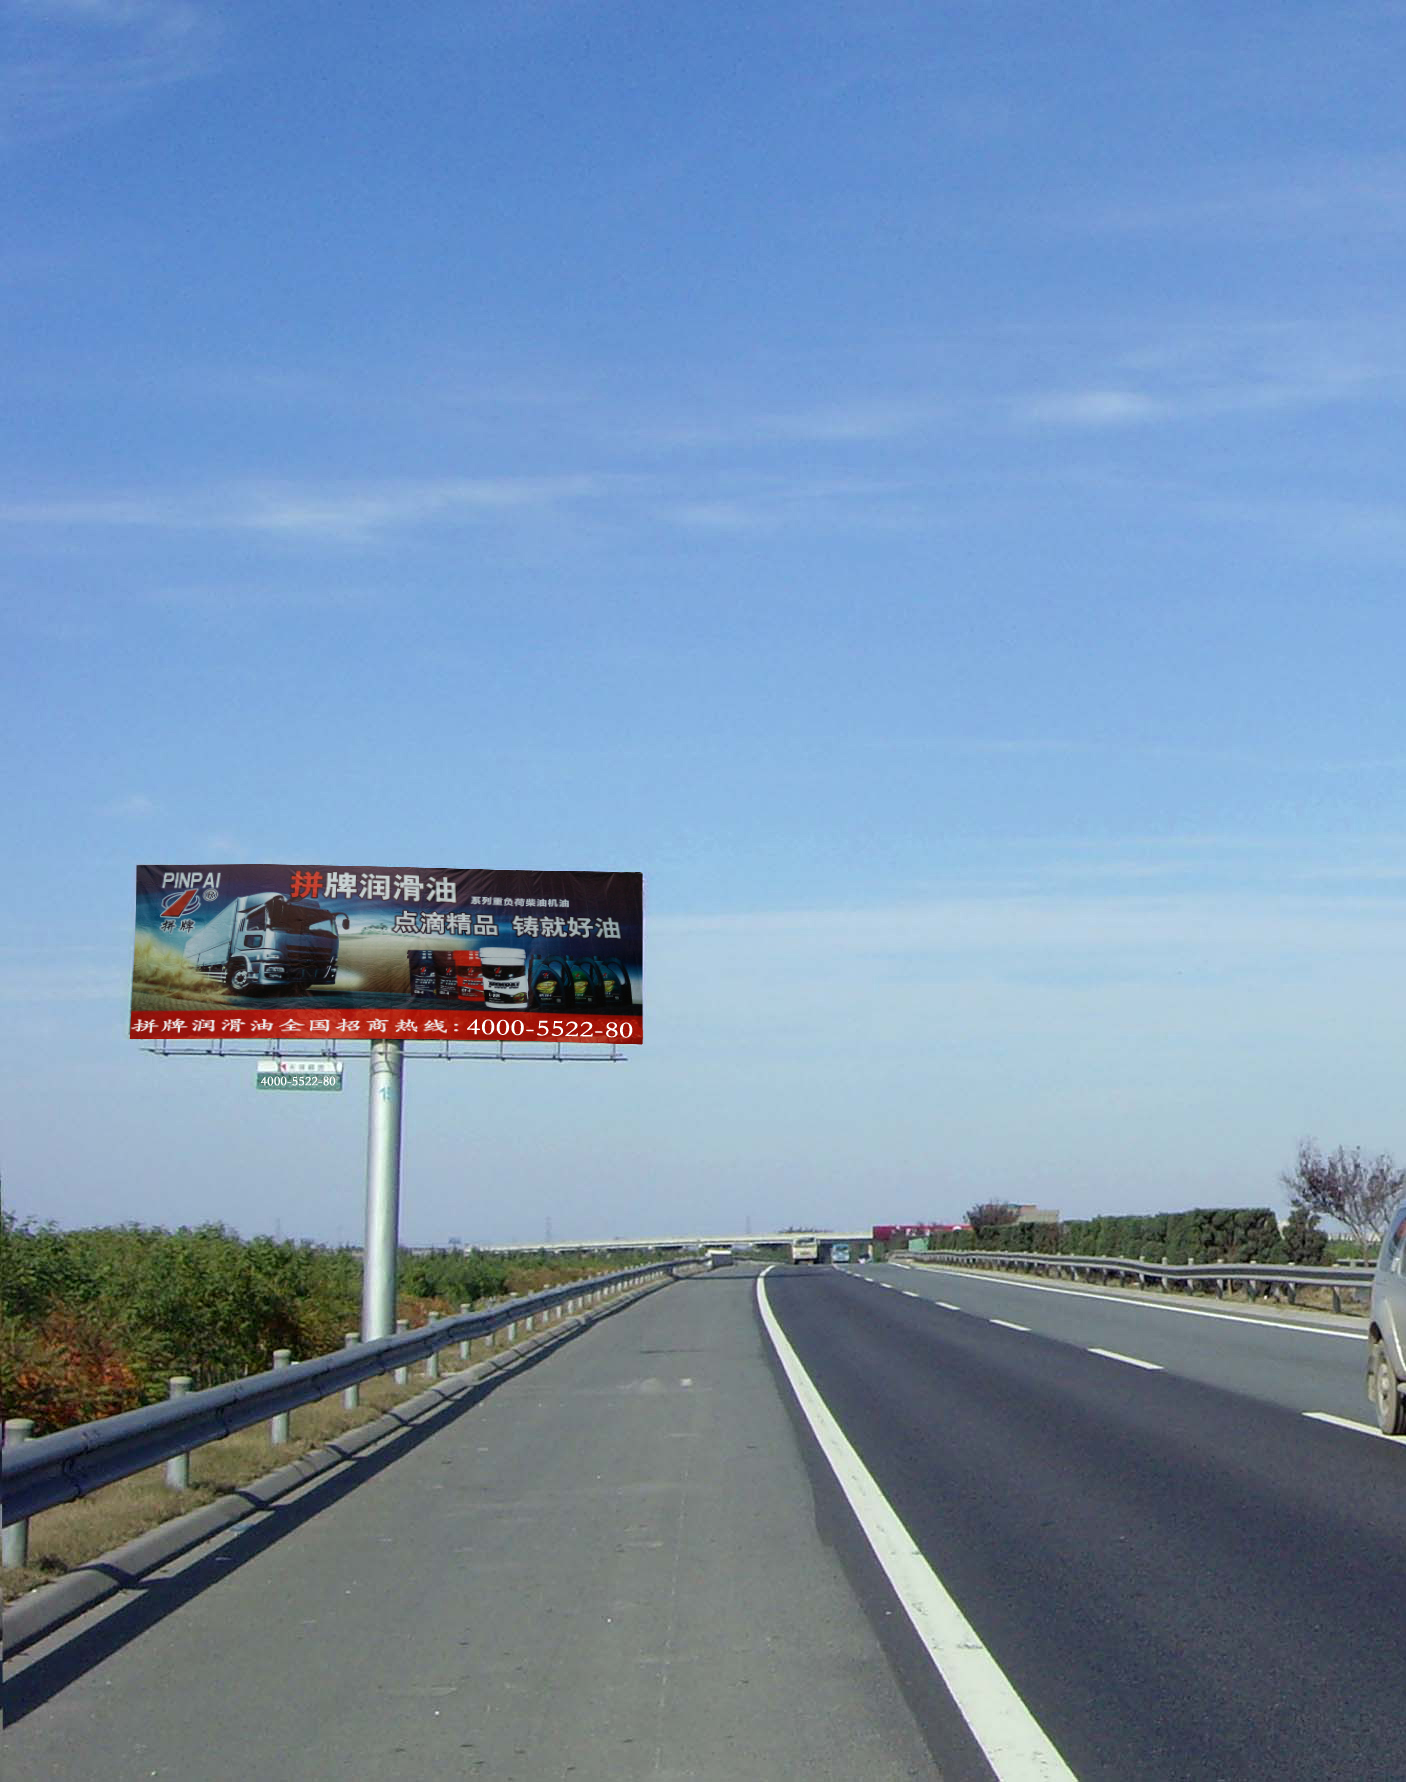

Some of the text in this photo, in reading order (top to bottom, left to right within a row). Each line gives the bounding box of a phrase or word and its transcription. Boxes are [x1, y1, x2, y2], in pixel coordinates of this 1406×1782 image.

[162, 872, 221, 889] PINPAI
[290, 871, 457, 903] 拼牌润滑油
[392, 910, 622, 939] 点滴精品 铸就好油
[260, 1076, 336, 1086] 4000-5522-80
